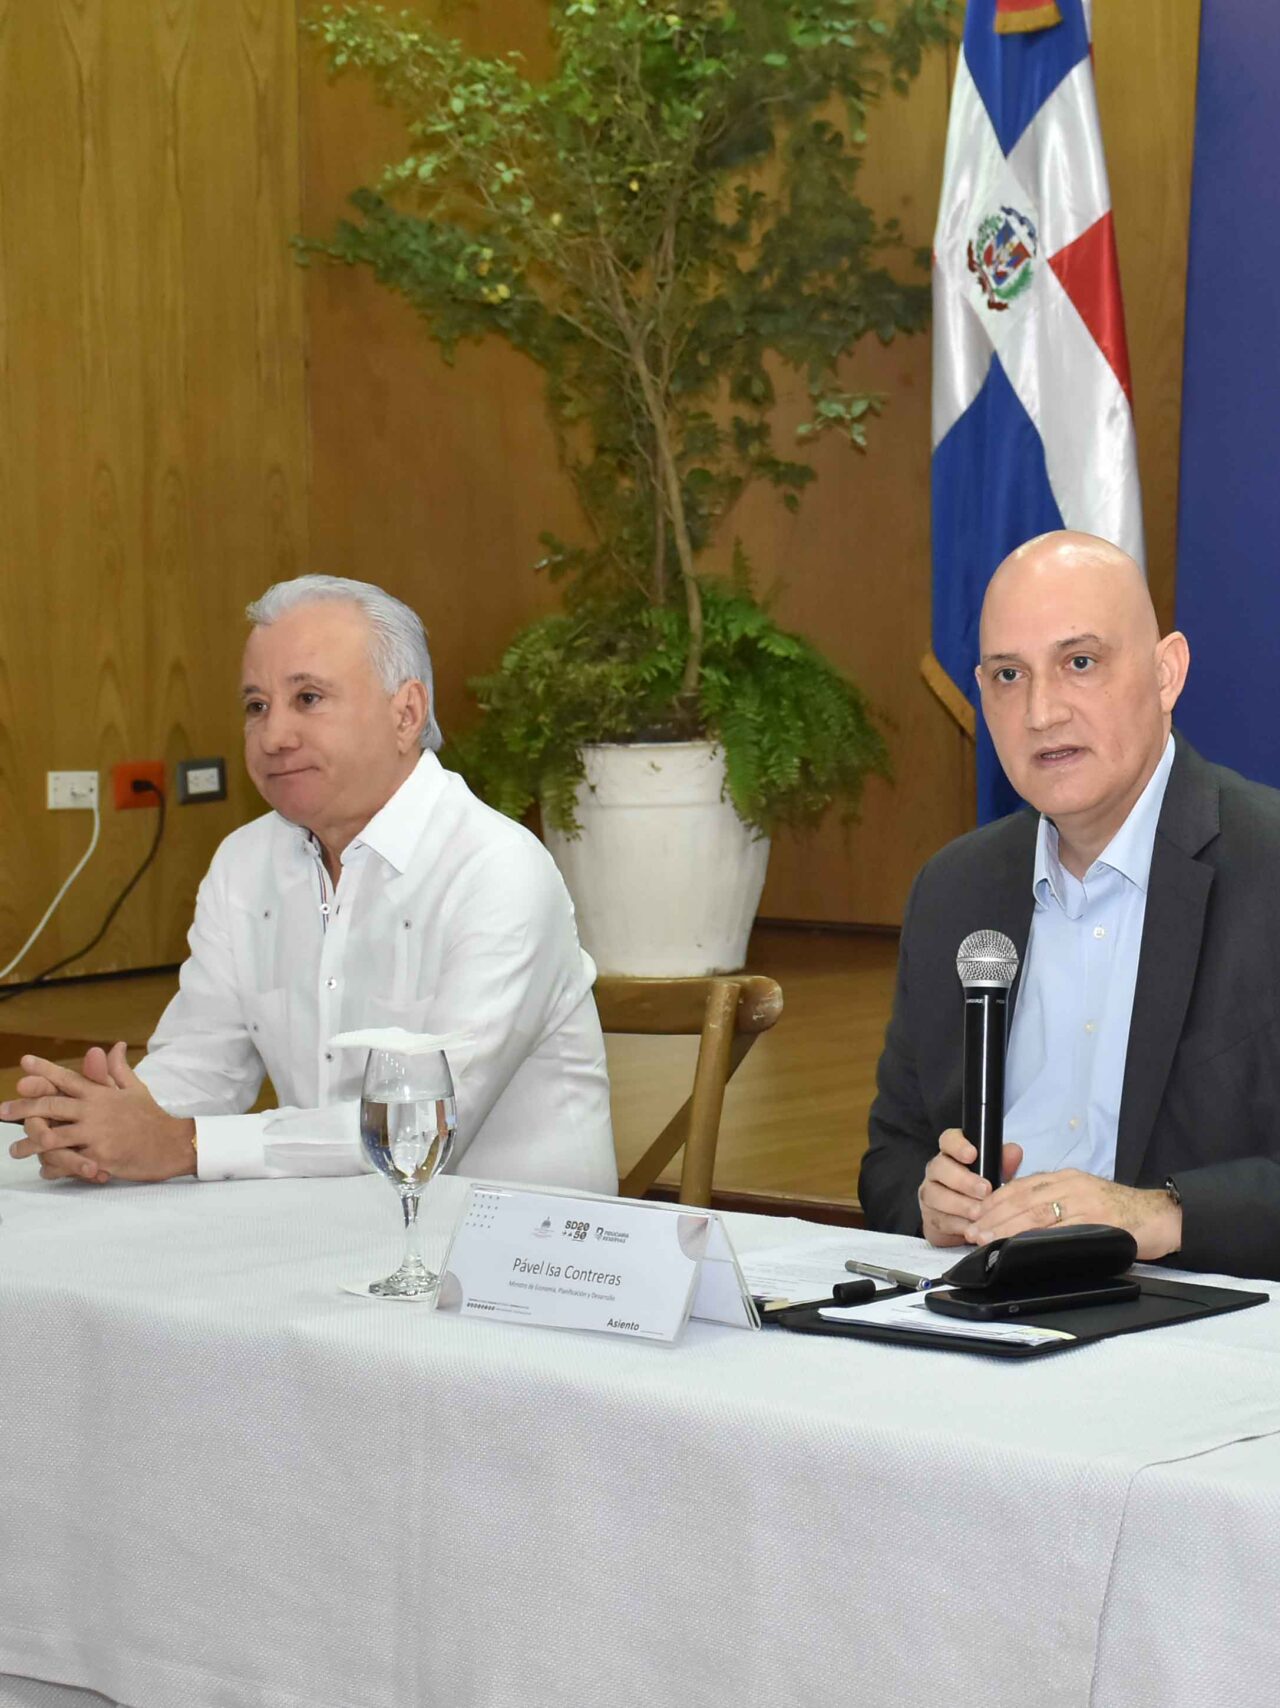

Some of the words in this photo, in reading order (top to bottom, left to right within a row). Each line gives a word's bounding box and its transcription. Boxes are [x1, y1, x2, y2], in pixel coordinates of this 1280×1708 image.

[565, 1220, 590, 1231] SD20
[573, 1231, 587, 1240] 50
[512, 1258, 544, 1275] Pável
[546, 1262, 561, 1277] Isa
[564, 1265, 622, 1286] Contreras
[607, 1318, 640, 1332] Asiento
